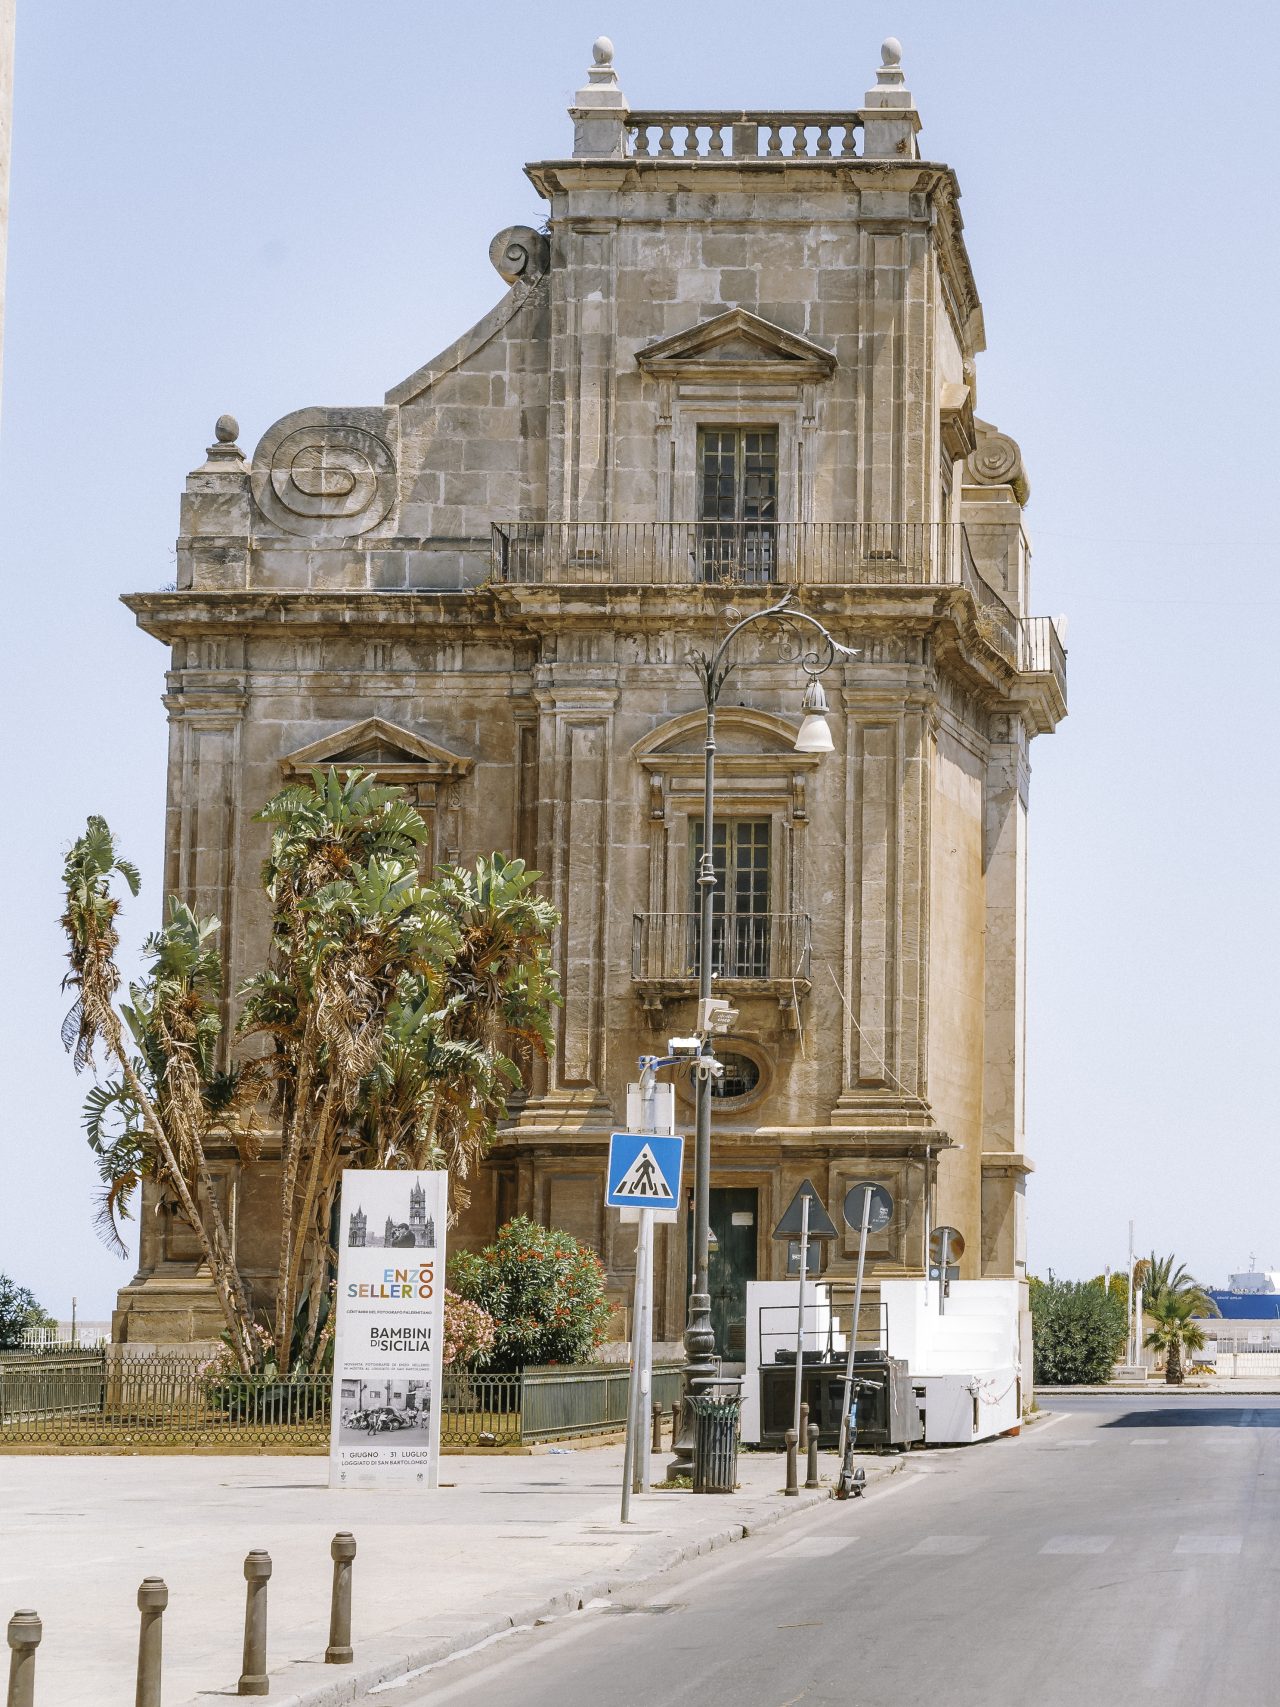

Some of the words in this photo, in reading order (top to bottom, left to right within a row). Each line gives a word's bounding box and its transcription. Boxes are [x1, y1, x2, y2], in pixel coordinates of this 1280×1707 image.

[383, 1269, 434, 1284] ENZO
[347, 1284, 433, 1299] SELLERIO
[370, 1327, 431, 1339] BAMBINI
[370, 1339, 380, 1347] DI
[380, 1340, 431, 1352] SICILIA
